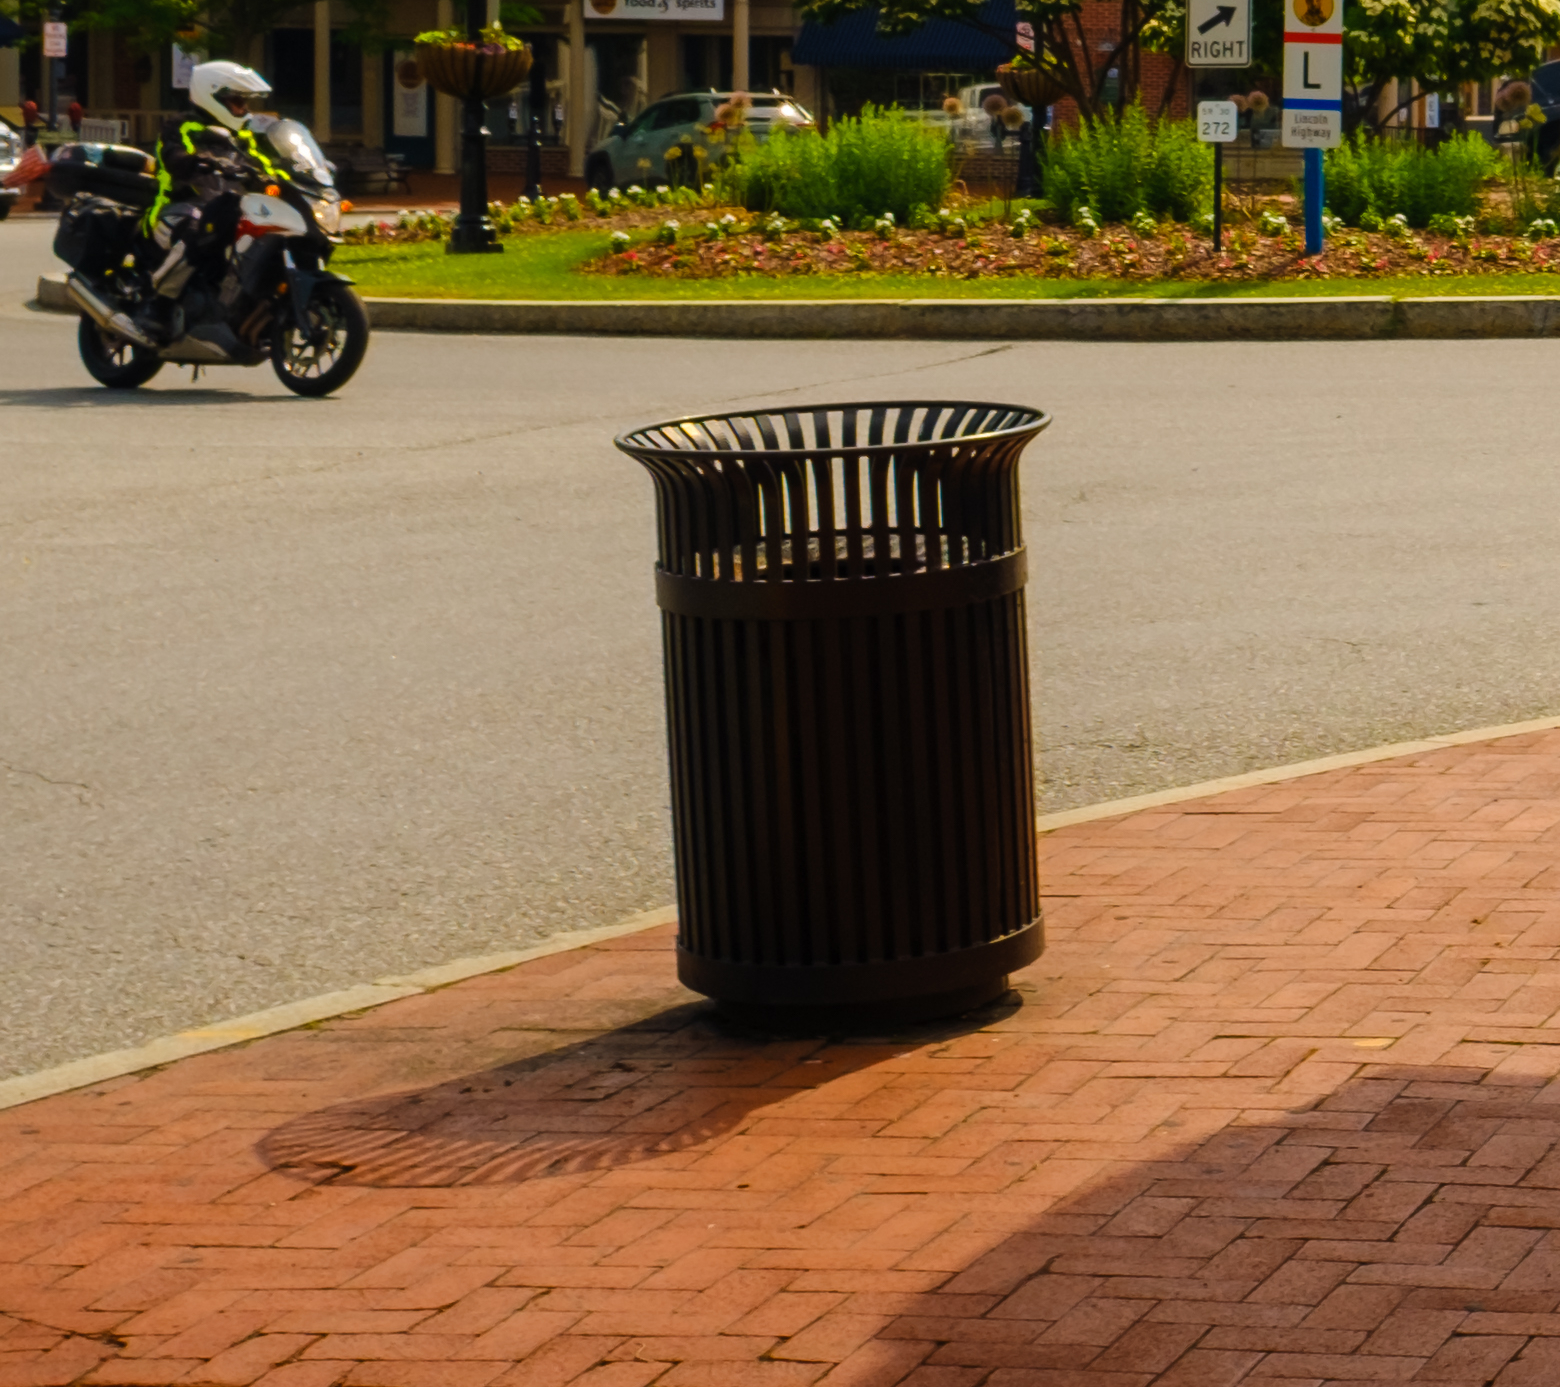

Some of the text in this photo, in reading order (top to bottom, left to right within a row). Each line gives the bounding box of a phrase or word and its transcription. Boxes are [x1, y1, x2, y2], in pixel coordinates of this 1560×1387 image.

[1191, 41, 1245, 58] RIGHT
[1303, 51, 1321, 89] L
[1294, 113, 1328, 124] Lincoln
[1202, 122, 1230, 135] 272
[1291, 128, 1331, 140] Highway
